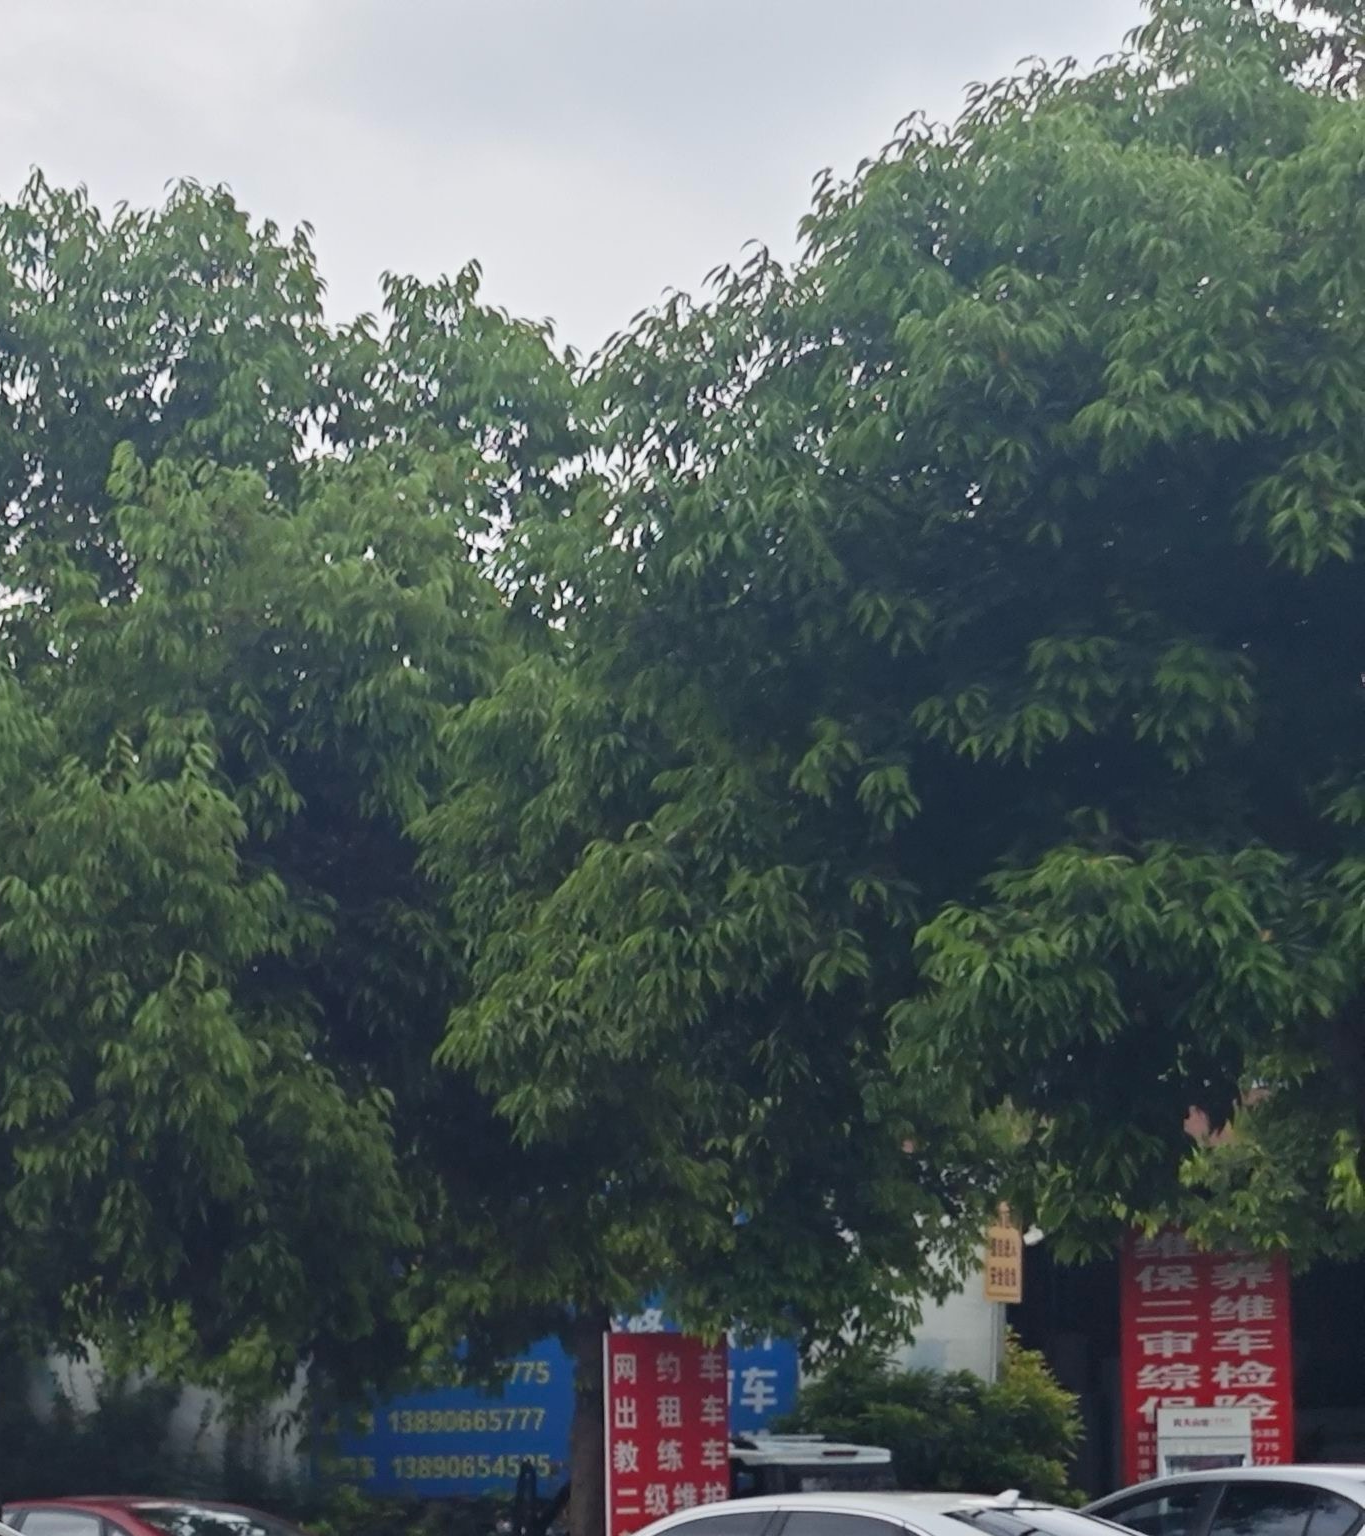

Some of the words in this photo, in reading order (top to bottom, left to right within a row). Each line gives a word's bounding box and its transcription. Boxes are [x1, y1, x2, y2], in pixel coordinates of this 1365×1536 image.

[1137, 1328, 1274, 1358] 审车
[614, 1352, 724, 1384] 网约车
[1137, 1361, 1277, 1390] 综检
[615, 1396, 725, 1429] 出租车
[392, 1454, 550, 1480] 1389065455
[614, 1439, 726, 1472] 教练车
[616, 1482, 727, 1516] 二级维护
